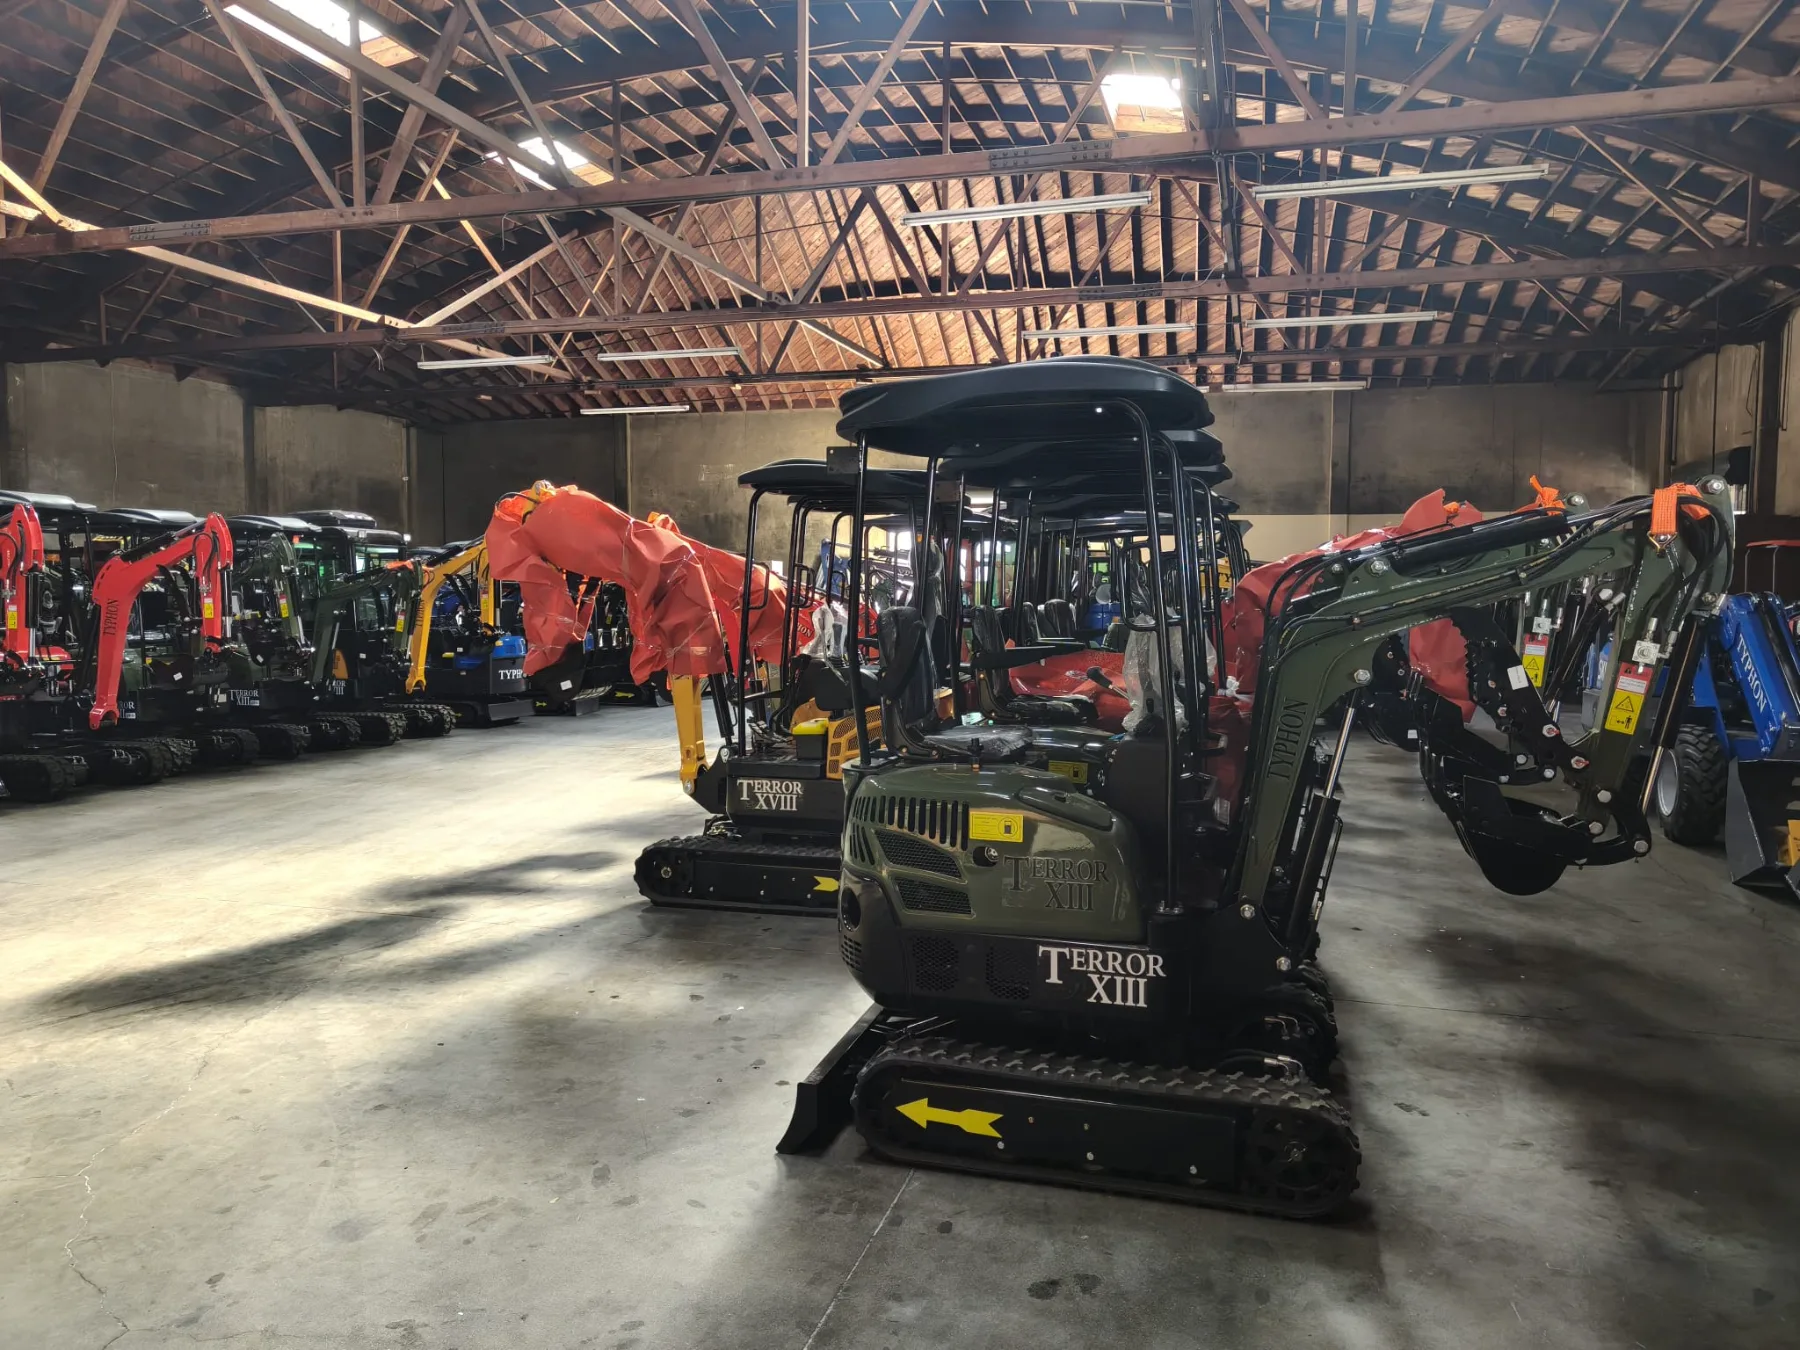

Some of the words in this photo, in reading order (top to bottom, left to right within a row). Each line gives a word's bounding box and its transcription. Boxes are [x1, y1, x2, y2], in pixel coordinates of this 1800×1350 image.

[103, 598, 119, 636] TYPHON
[797, 622, 813, 638] HON
[498, 668, 523, 680] TYPH
[1735, 634, 1768, 713] TYPHON
[229, 689, 259, 701] TERROR
[1266, 696, 1309, 780] TYPHON
[736, 779, 804, 801] TERROR
[754, 793, 798, 811] XVIII
[1003, 855, 1110, 892] TERROR
[1044, 880, 1095, 911] XIII
[1038, 945, 1167, 985] TERROR
[1086, 973, 1148, 1008] XIII
